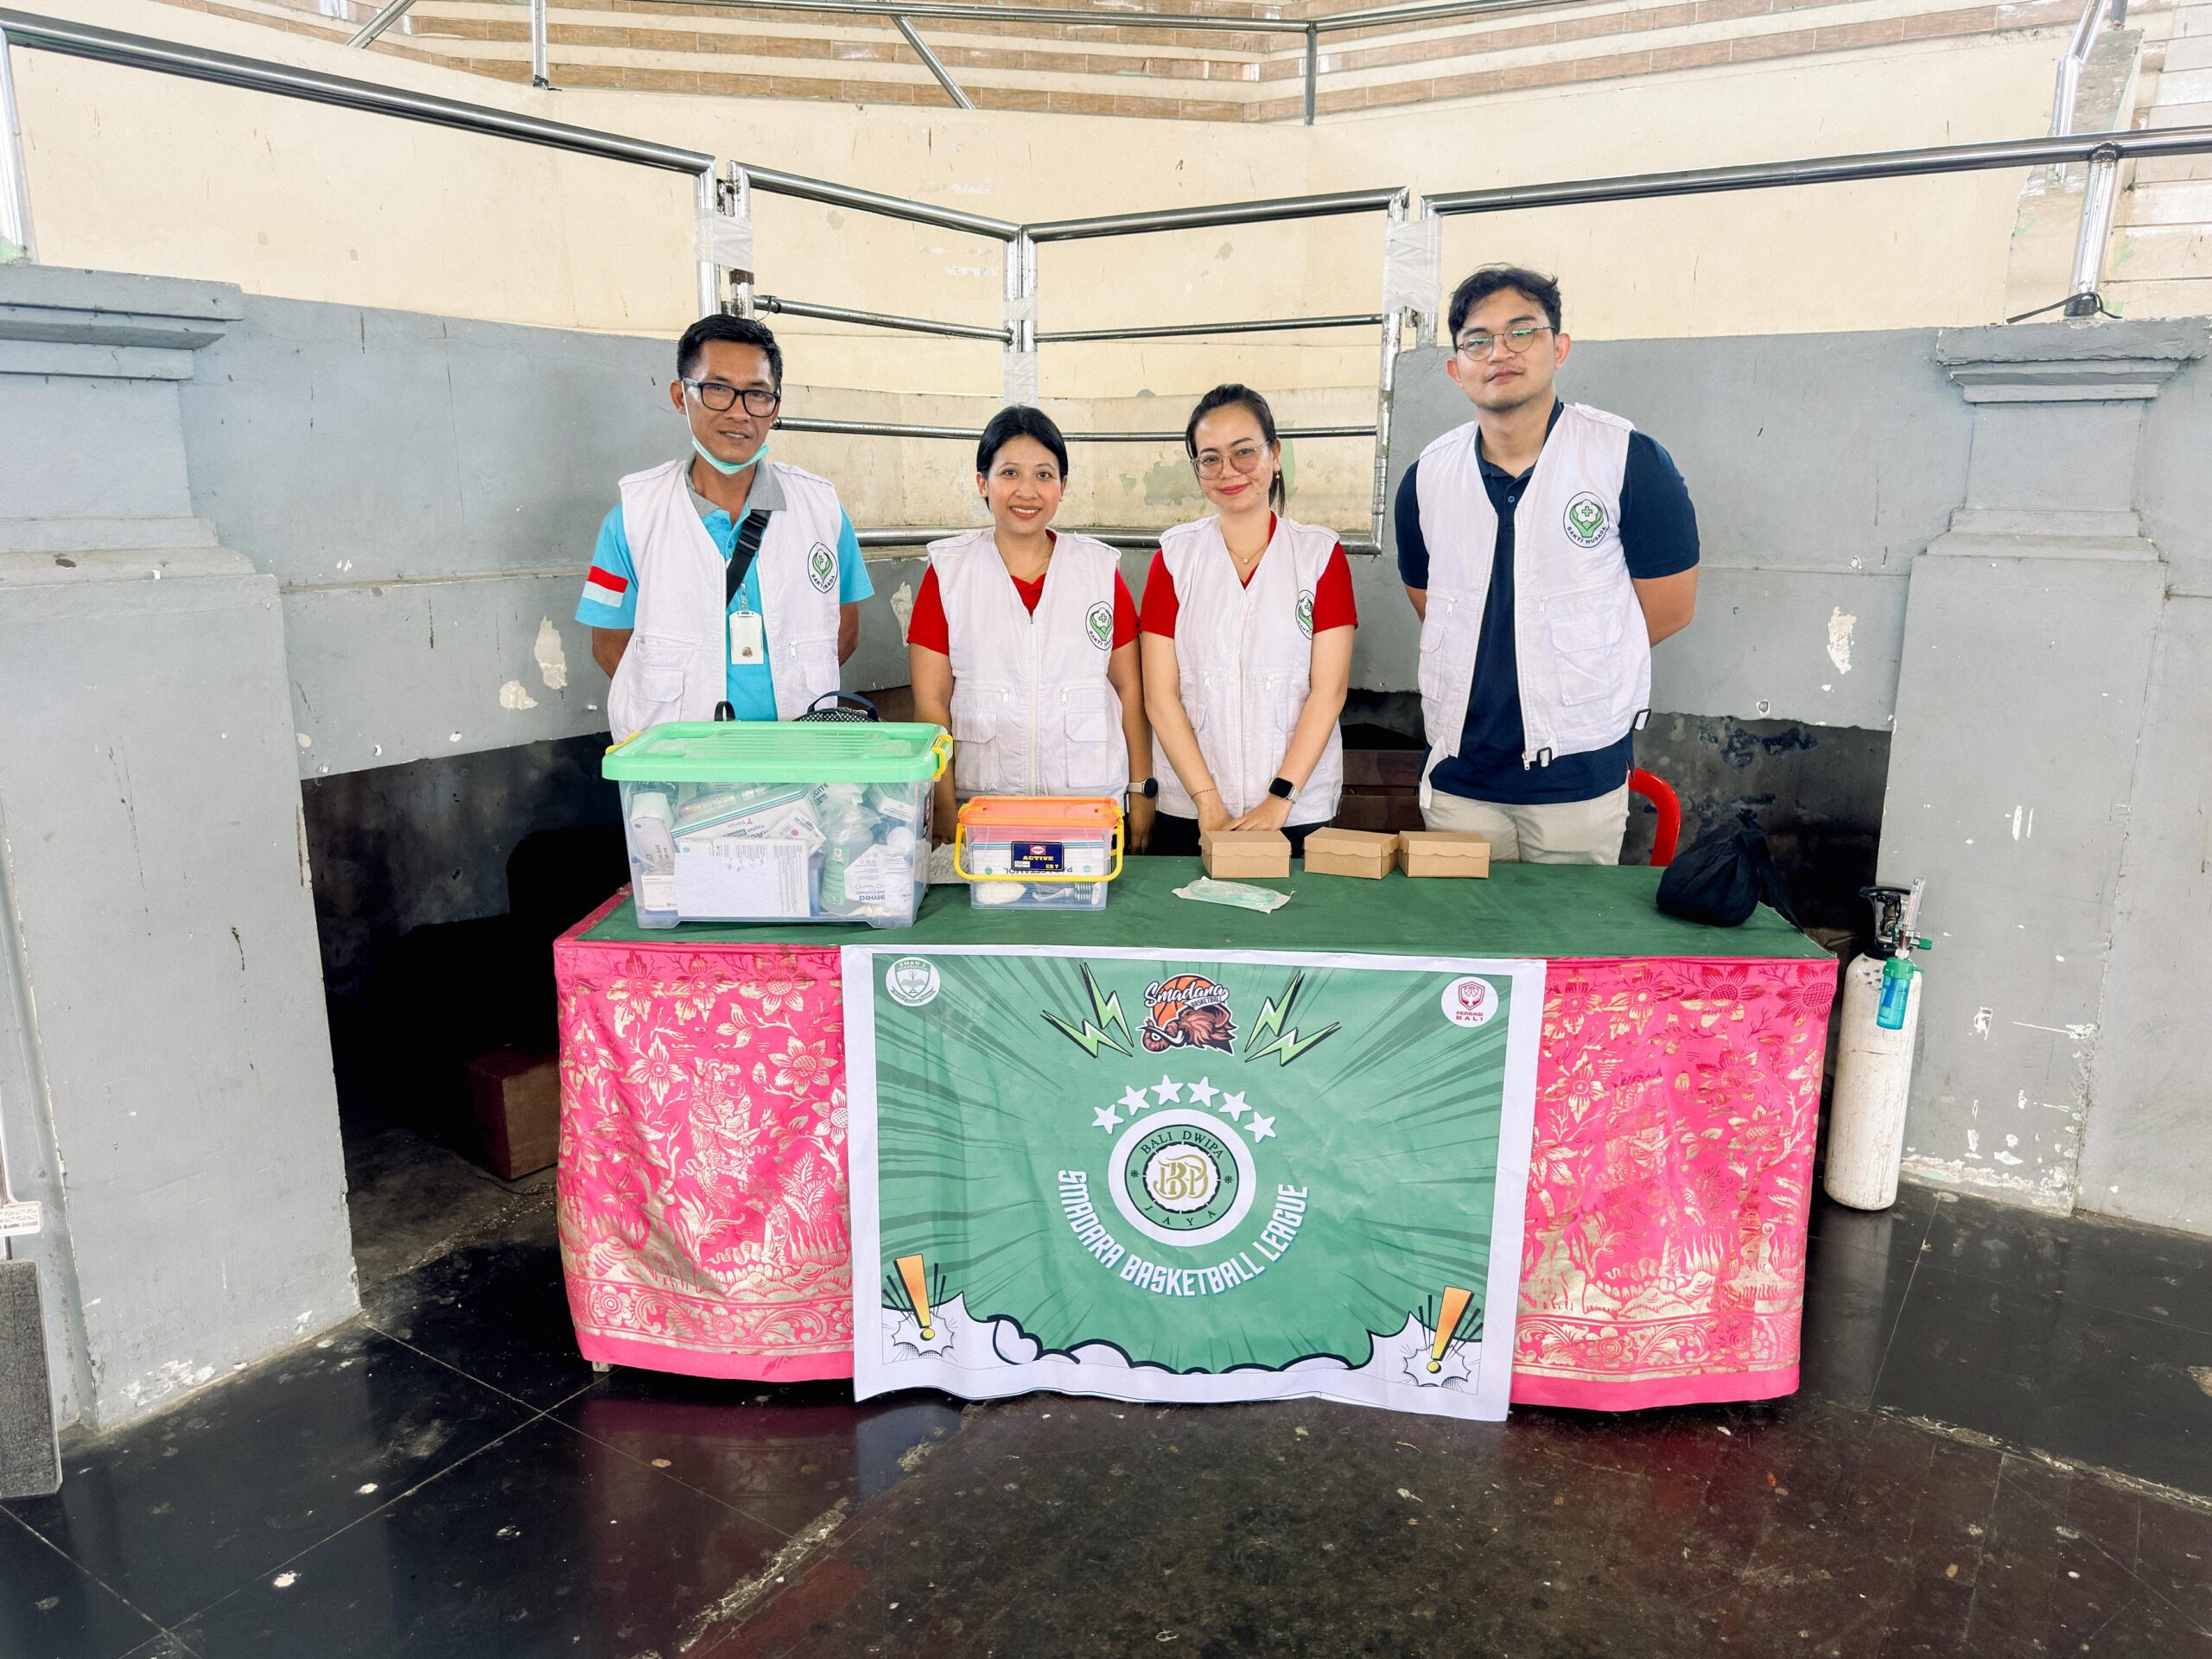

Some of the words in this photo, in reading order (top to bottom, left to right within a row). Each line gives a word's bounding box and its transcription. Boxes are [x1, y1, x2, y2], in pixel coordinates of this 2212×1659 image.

[1567, 526, 1584, 543] BAKTI
[1586, 526, 1607, 544] HUSADA
[813, 782, 830, 798] GITE
[1191, 995, 1222, 1007] BASKETBALL
[1140, 1131, 1173, 1155] BALI
[1182, 1130, 1224, 1160] DWIPA
[1144, 1205, 1217, 1226] JAYA
[1058, 1169, 1126, 1270] SMADARA
[1119, 1250, 1266, 1297] BASKETBALL
[1251, 1184, 1308, 1262] LEAGUE
